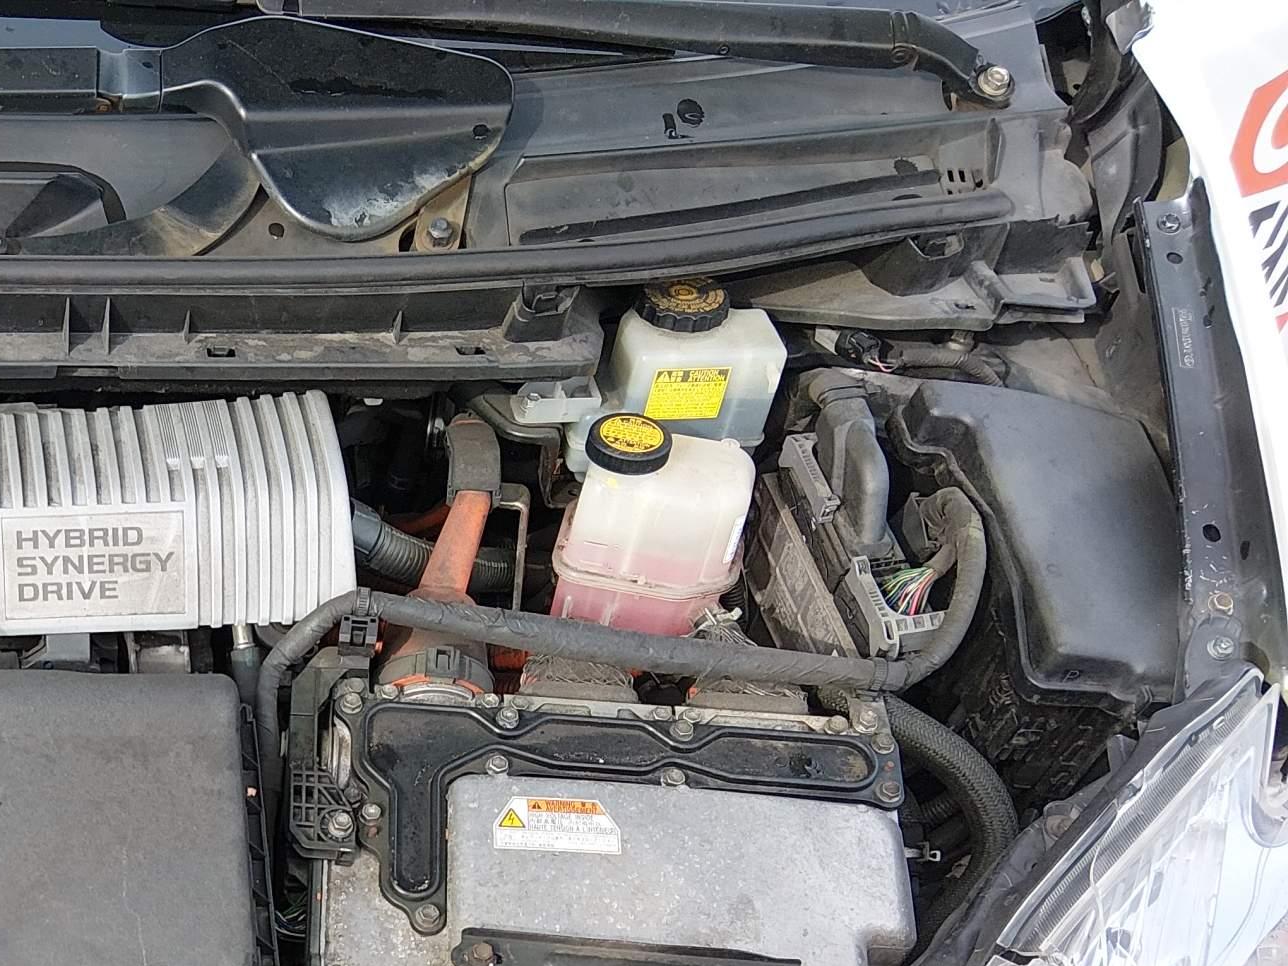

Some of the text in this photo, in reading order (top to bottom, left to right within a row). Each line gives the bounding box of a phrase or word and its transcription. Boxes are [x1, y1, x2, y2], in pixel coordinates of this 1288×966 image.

[16, 526, 144, 550] HYBRID
[17, 551, 175, 577] SYNERGY
[18, 580, 120, 602] DRIVE
[545, 799, 575, 808] WARNING
